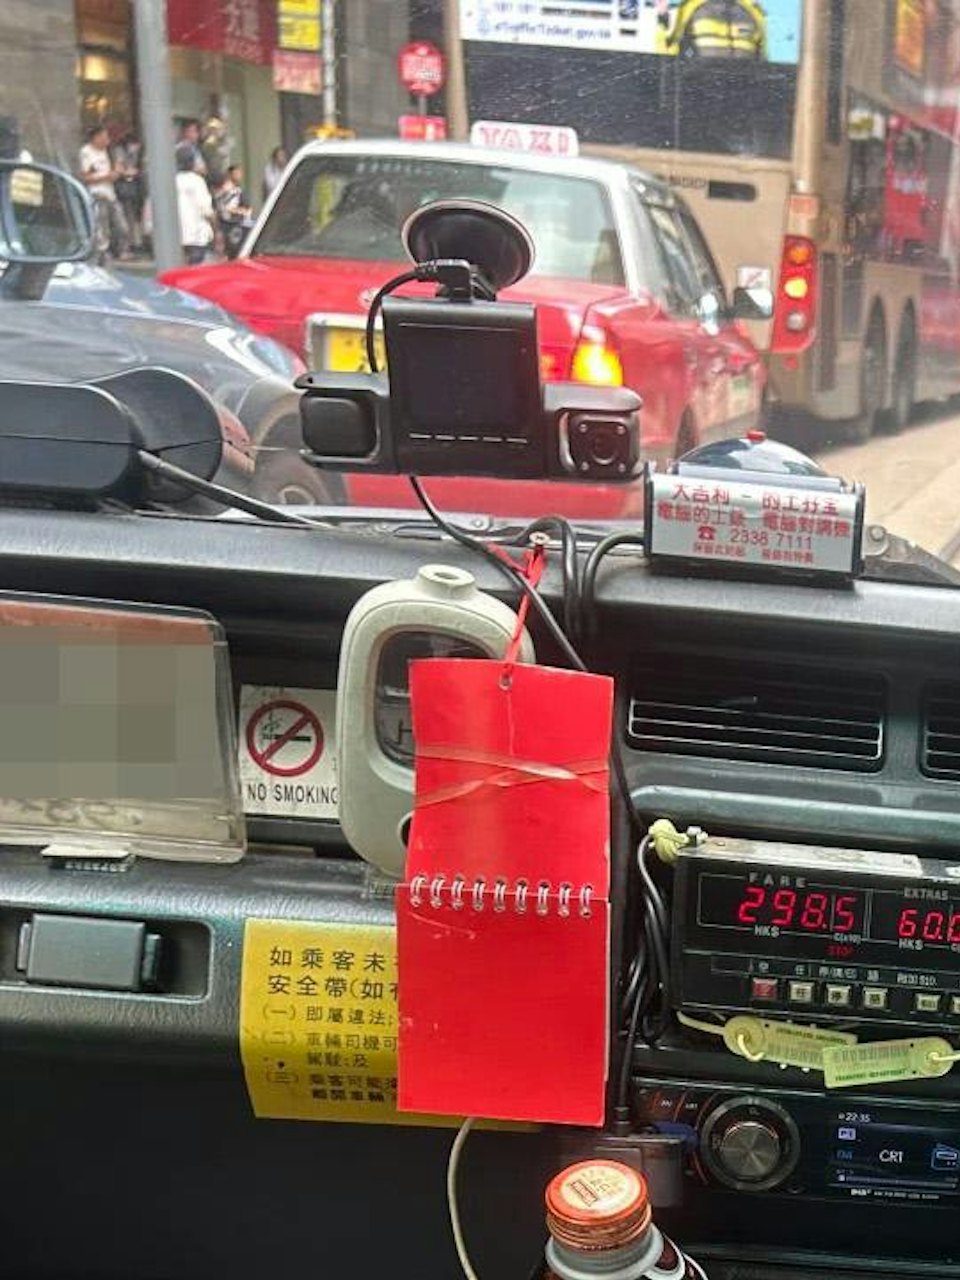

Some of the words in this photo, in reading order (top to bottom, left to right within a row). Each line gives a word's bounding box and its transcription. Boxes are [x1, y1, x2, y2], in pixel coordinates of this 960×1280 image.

[479, 126, 571, 154] TAXI
[730, 528, 769, 546] 2338
[776, 533, 813, 549] 7111
[247, 783, 268, 802] NO
[748, 872, 807, 889] FARE
[903, 887, 950, 901] EXTRAS
[269, 945, 397, 973] 如乘客未
